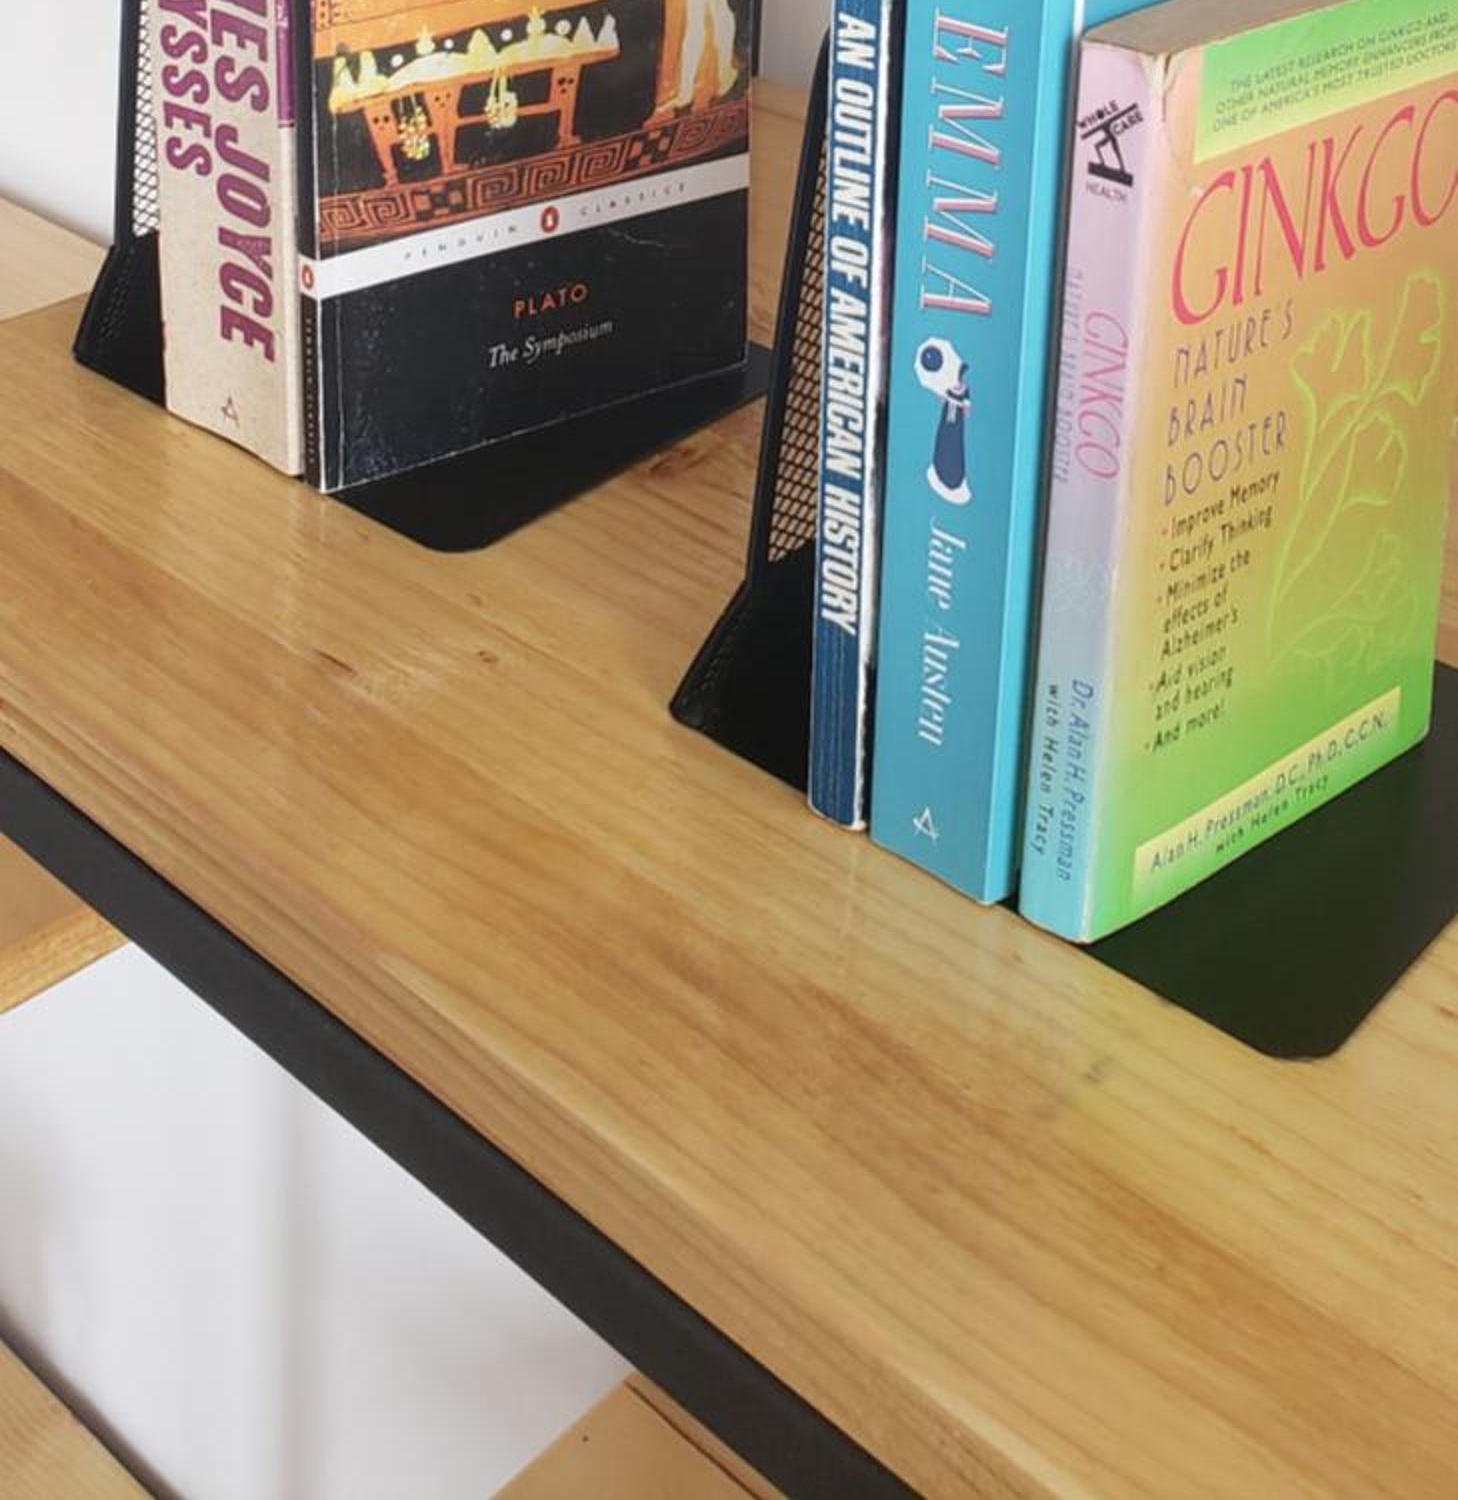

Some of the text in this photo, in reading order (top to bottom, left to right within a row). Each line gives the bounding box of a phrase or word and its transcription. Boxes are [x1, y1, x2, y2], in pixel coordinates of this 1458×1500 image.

[1077, 100, 1118, 128] WHOLE
[1110, 111, 1144, 135] CARE
[920, 8, 1008, 315] EMMA
[214, 123, 276, 363] JOYCE
[404, 182, 686, 261] PENGUIN CLASSICS
[1172, 89, 1458, 325] GINKGO
[512, 282, 589, 320] PLATO
[821, 12, 878, 637] AN OUTLINE OF AMERICAN HISTORY
[488, 320, 613, 369] The Symposium
[1174, 298, 1293, 389] NATURE'S
[1074, 311, 1128, 479] GINKGO
[1168, 372, 1248, 447] BRAIN
[1165, 410, 1286, 507] BOOSTER
[1170, 505, 1272, 572] Clarify Thinking
[1172, 471, 1280, 539] Improve Memory
[1164, 581, 1229, 633] effects of
[1167, 550, 1250, 605] Minimize the
[917, 514, 967, 747] Jane Austen
[1155, 646, 1226, 692] Aid vision
[1156, 667, 1233, 721] and hearing
[1152, 698, 1224, 752] And more!
[1031, 683, 1059, 856] with Helen Tracy
[1056, 678, 1094, 882] Dr. Alan H. Pressman
[1216, 775, 1329, 853] with Helen Tracy
[1151, 842, 1184, 870] Alan
